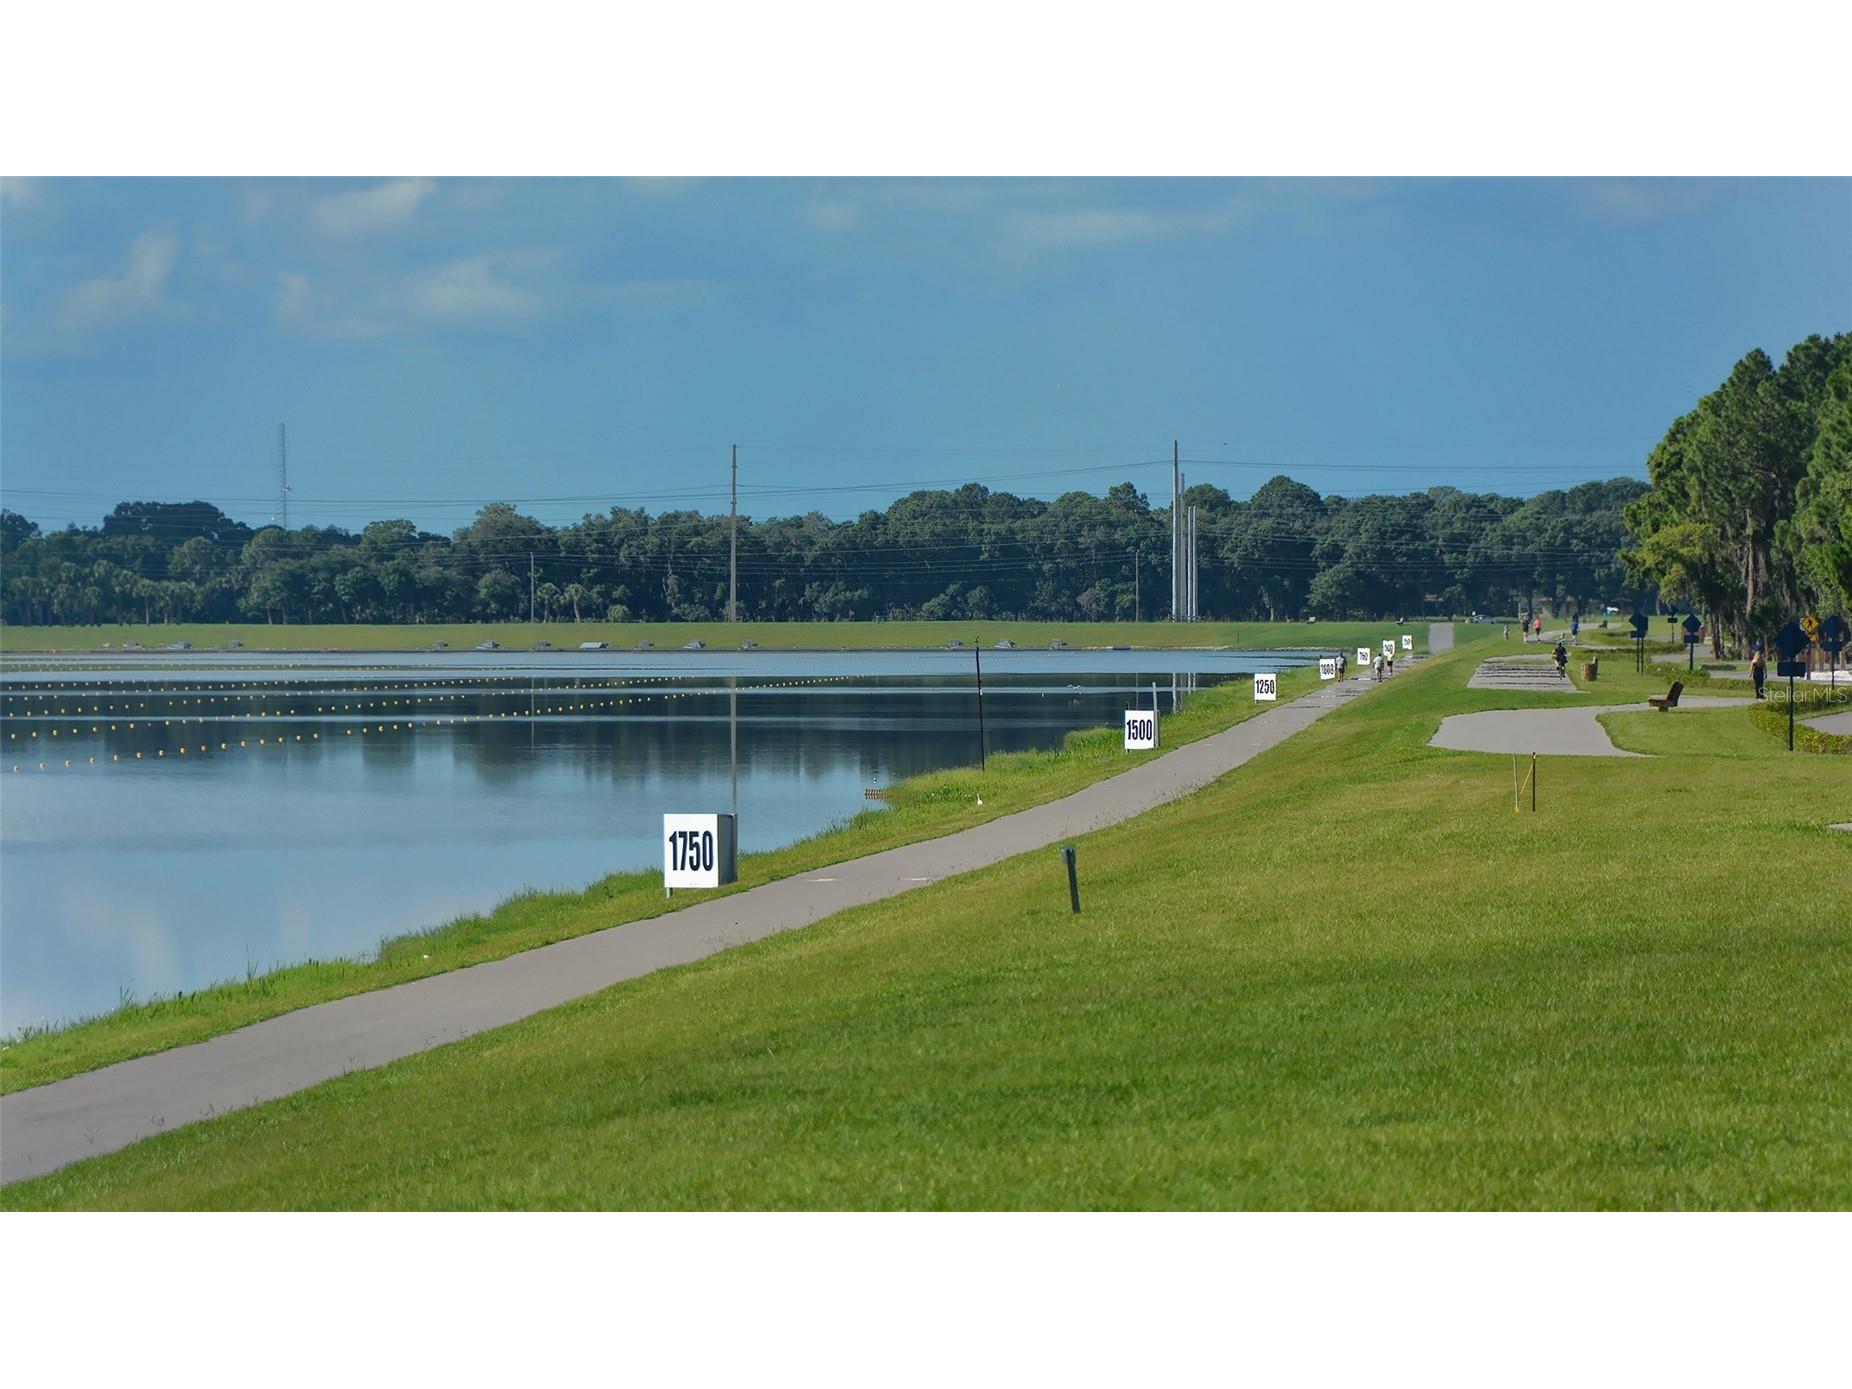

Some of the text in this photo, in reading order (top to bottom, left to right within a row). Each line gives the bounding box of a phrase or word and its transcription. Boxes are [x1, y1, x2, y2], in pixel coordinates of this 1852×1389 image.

[1256, 679, 1275, 694] 1250
[1126, 719, 1153, 741] 1500
[668, 830, 714, 871] 1750
